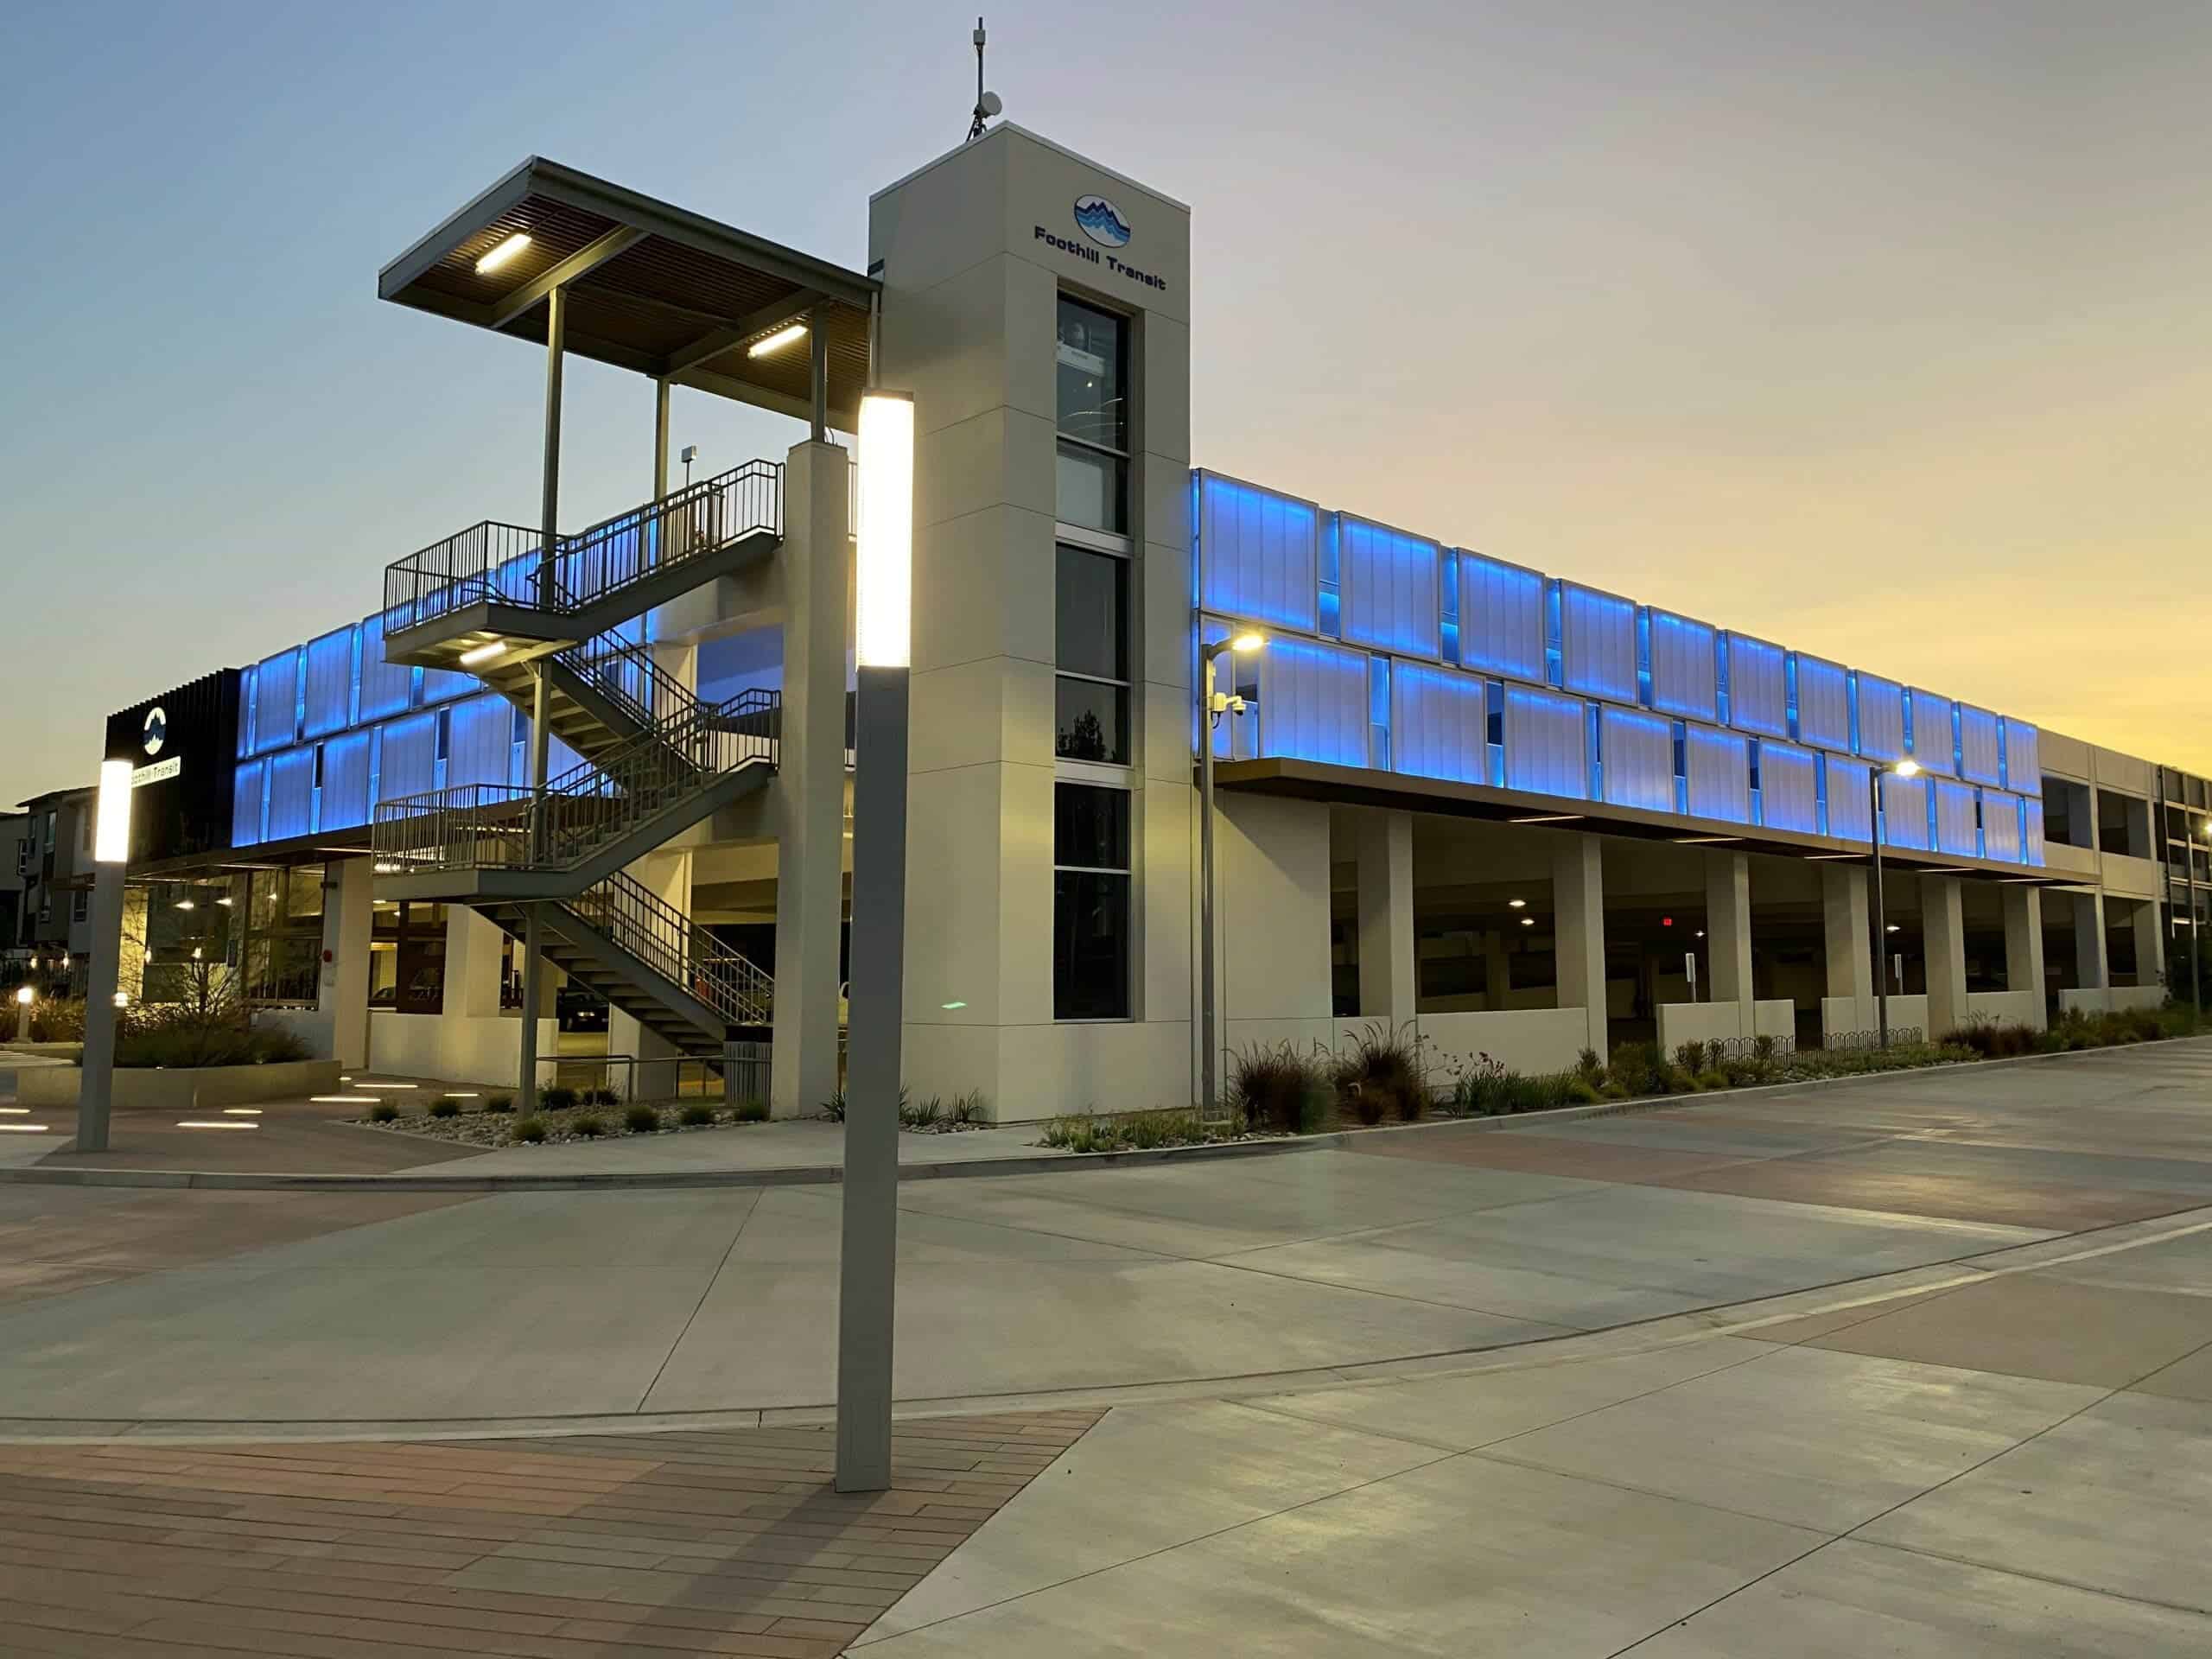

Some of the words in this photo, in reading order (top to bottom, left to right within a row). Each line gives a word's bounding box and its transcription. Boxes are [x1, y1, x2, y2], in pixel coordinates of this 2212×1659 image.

[1034, 226, 1099, 264] Foothill
[1106, 255, 1166, 290] Transit
[153, 761, 179, 779] Transit
